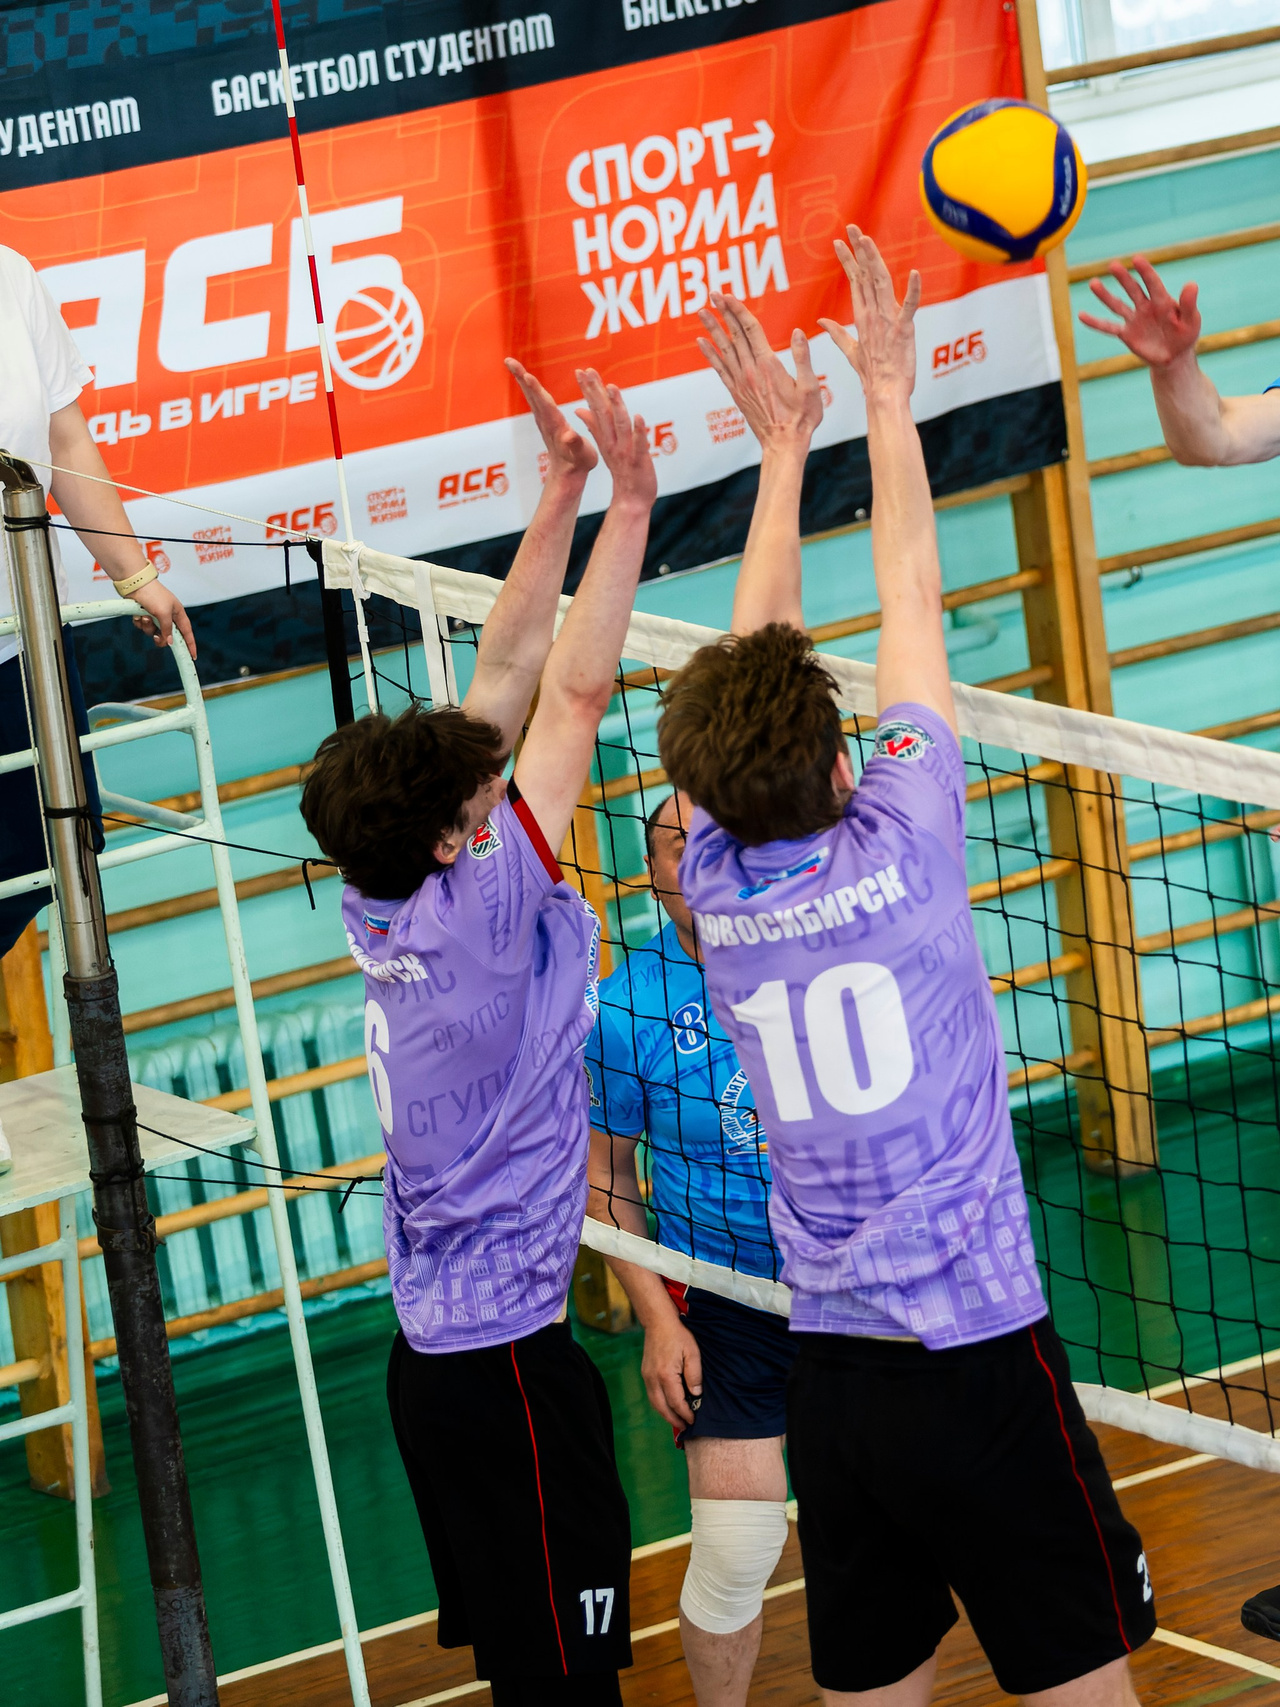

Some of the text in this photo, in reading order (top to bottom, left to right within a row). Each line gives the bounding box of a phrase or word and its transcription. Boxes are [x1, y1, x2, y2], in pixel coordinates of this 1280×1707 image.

[384, 13, 555, 77] СТУДЕНТАМ
[566, 117, 733, 209] СПОРТ
[572, 172, 778, 276] НОРМА
[580, 234, 790, 340] ЖИЗНИ
[159, 396, 192, 432] В
[199, 371, 318, 424] ИГРЕ
[438, 462, 510, 500] АСБ
[433, 991, 510, 1053] СГУПС
[673, 1002, 708, 1055] 8
[732, 961, 913, 1122] 10
[579, 1588, 614, 1635] 17
